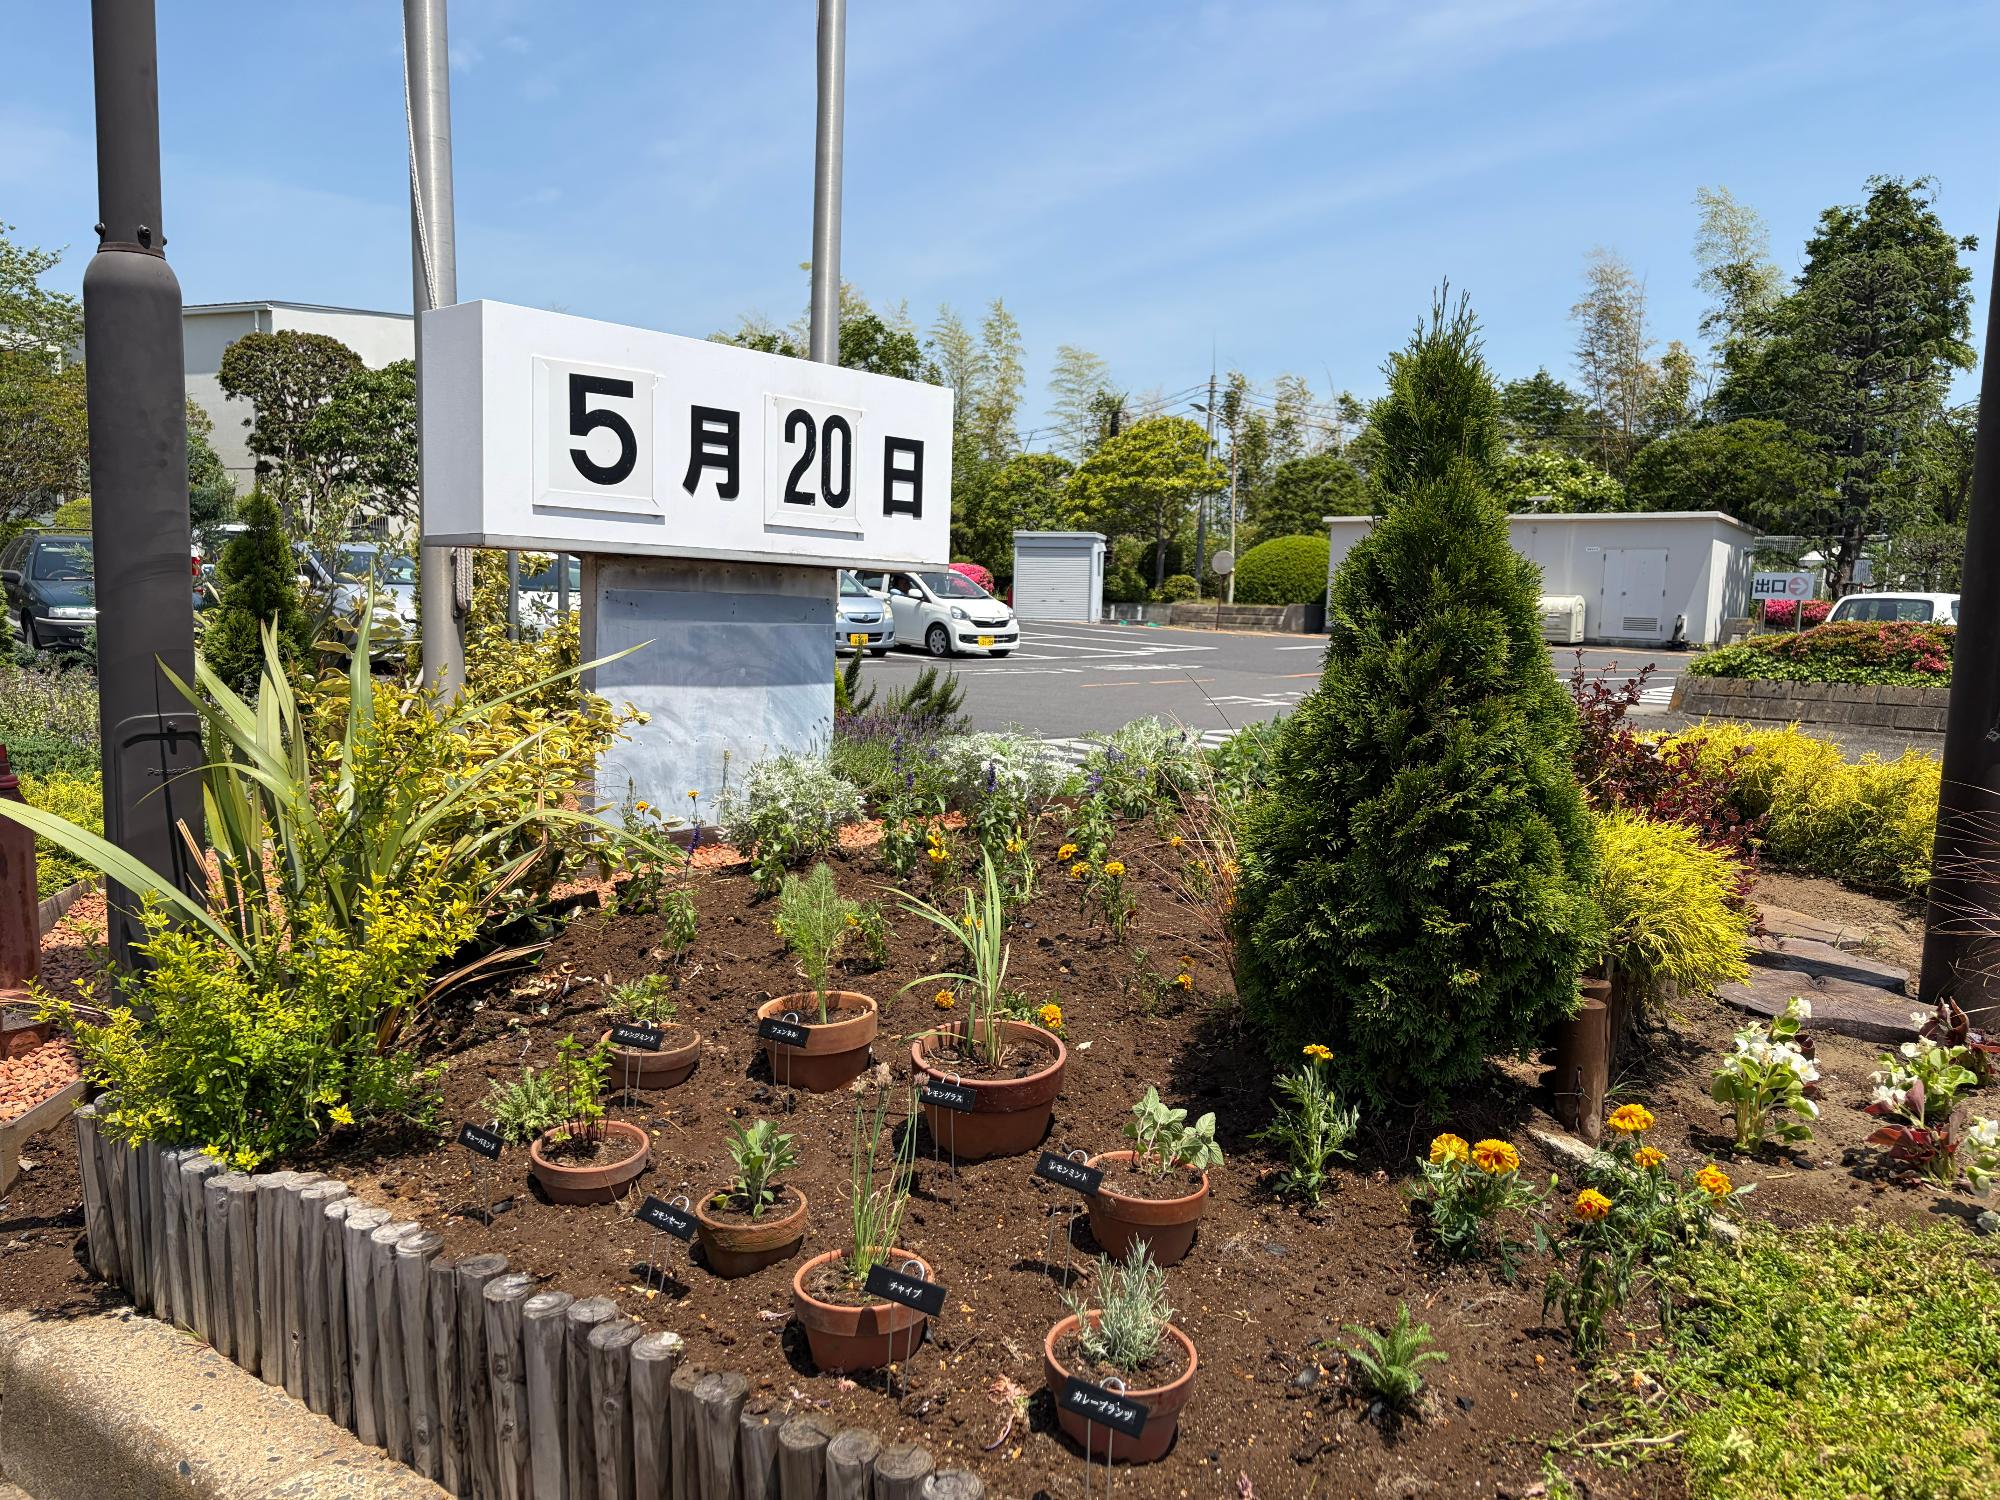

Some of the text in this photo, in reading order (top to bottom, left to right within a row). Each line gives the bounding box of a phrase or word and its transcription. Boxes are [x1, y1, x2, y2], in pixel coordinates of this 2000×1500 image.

[1754, 577, 1787, 594] 出口
[927, 1087, 963, 1103] レモングラス
[1049, 1160, 1089, 1182] レモンミント
